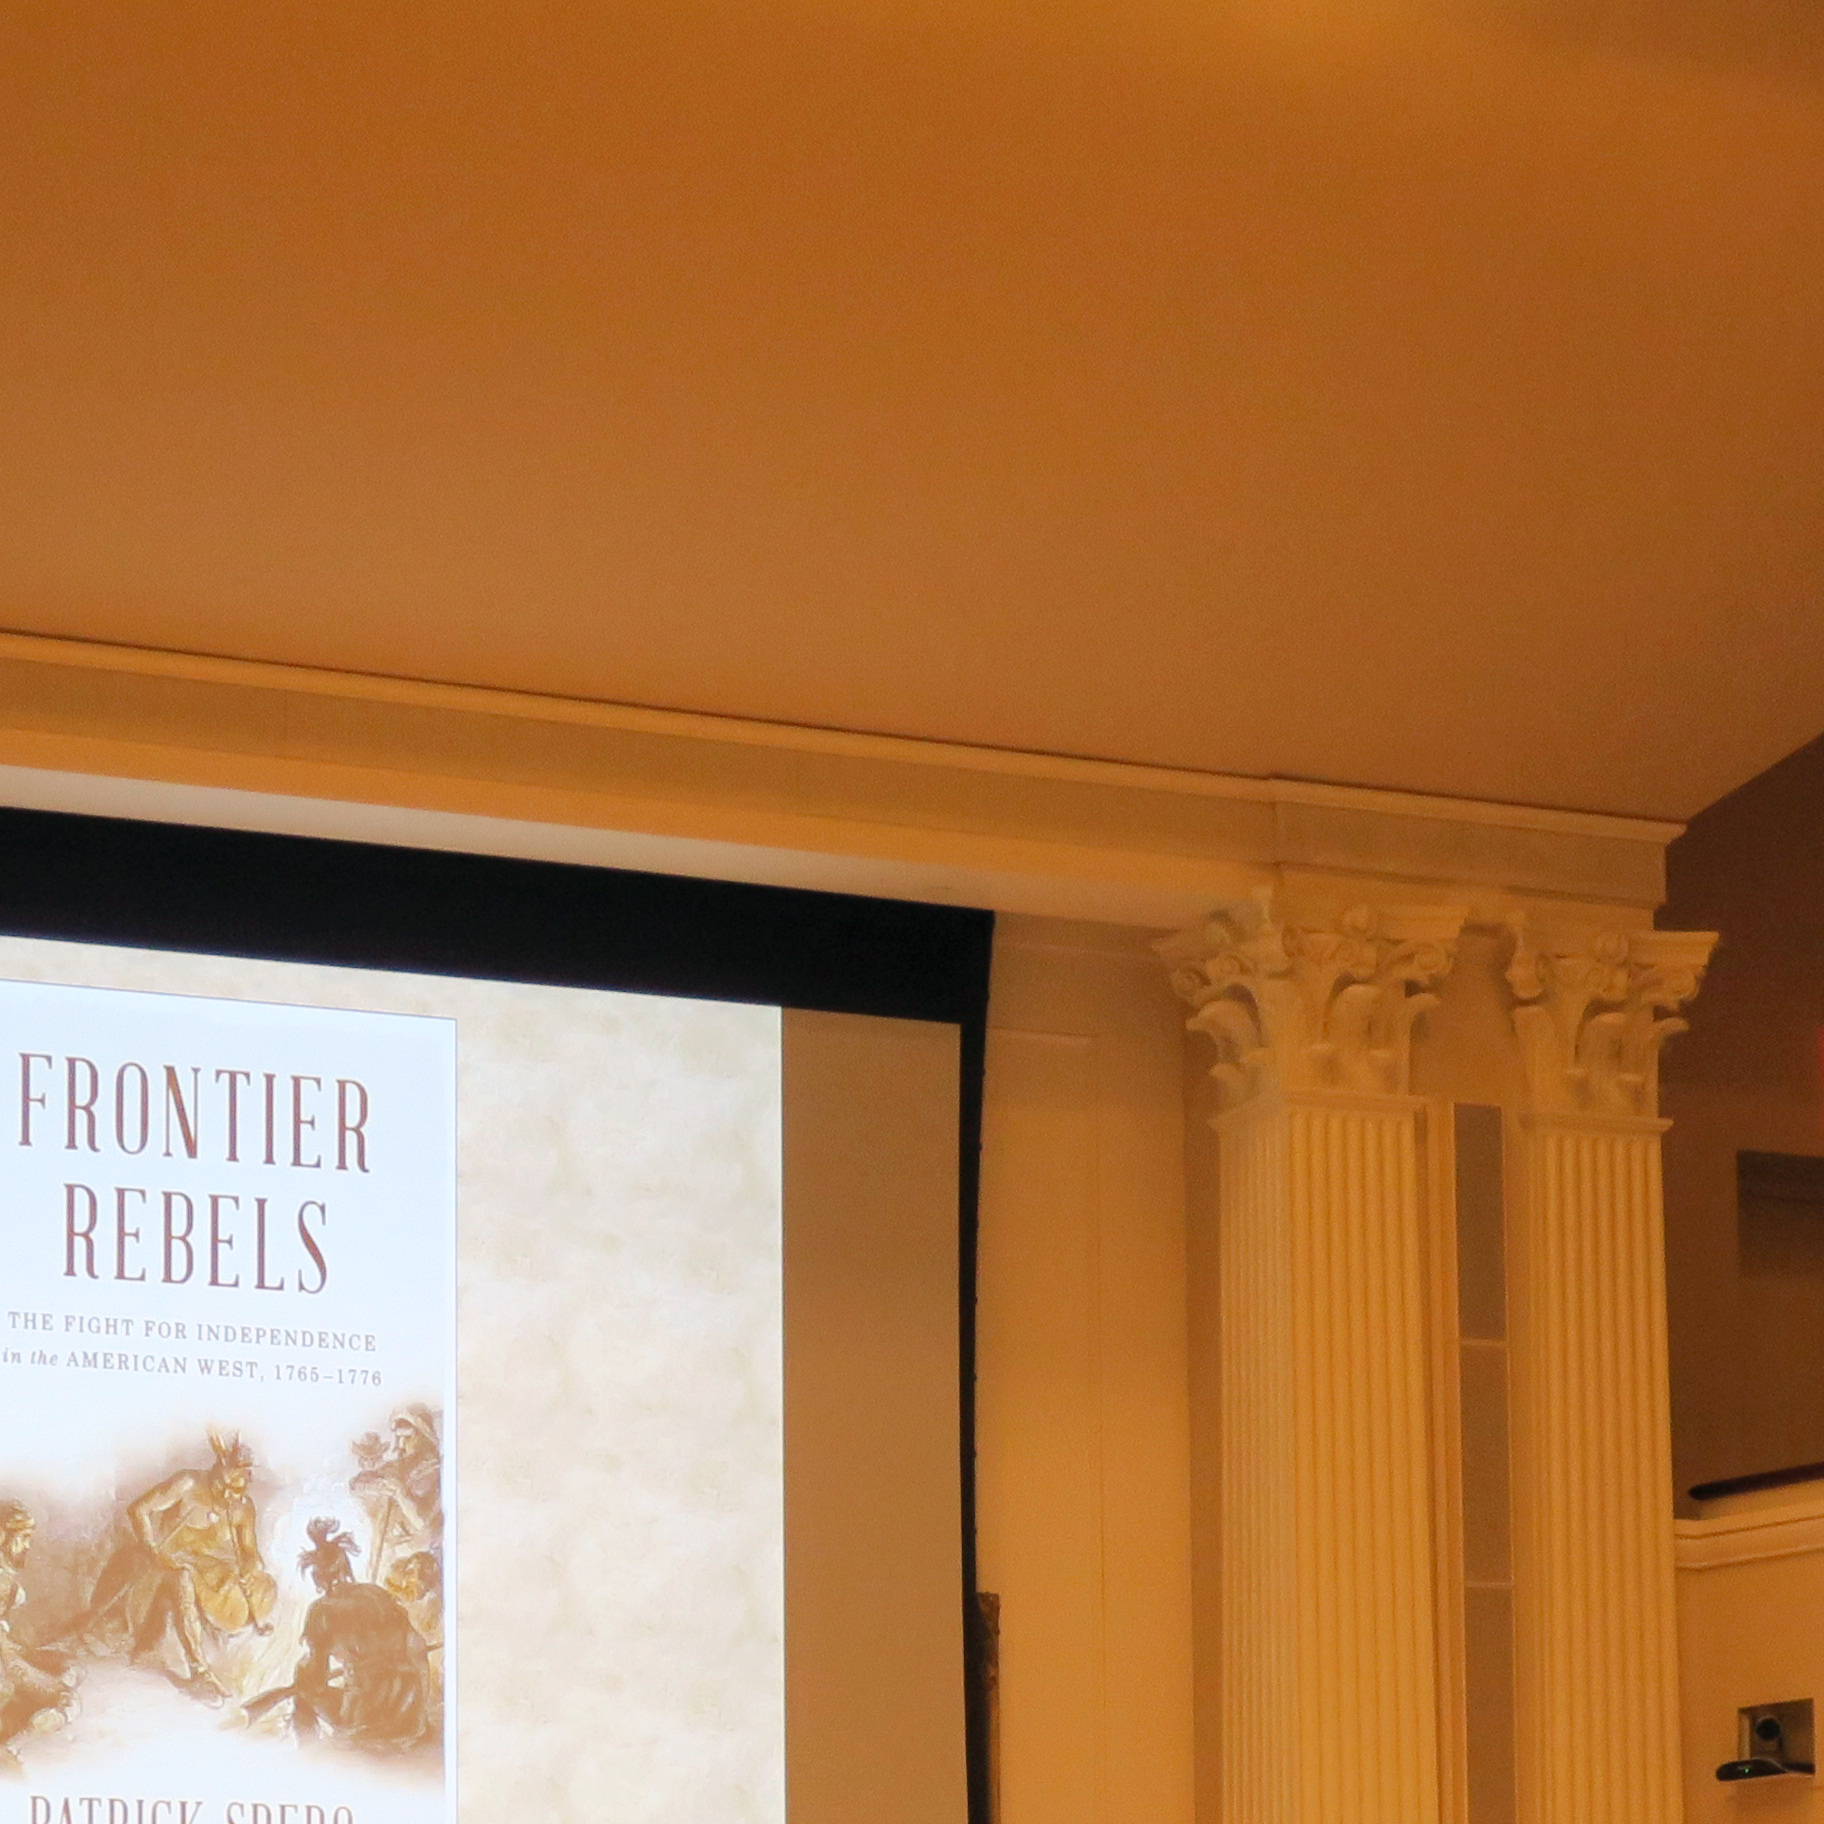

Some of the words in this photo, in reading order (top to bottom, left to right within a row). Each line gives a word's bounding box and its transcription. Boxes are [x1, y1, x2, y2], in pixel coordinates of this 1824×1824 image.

[18, 1052, 370, 1173] FRONTIER
[64, 1183, 328, 1294] REBELS
[2, 1347, 23, 1365] in
[30, 1348, 59, 1367] the
[66, 1352, 189, 1376] AMERICAN
[198, 1359, 266, 1383] WEST,
[7, 1311, 55, 1333] THE
[64, 1315, 135, 1337] FIGHT
[144, 1320, 188, 1341] FOR
[197, 1323, 378, 1353] INDEPENDENCE
